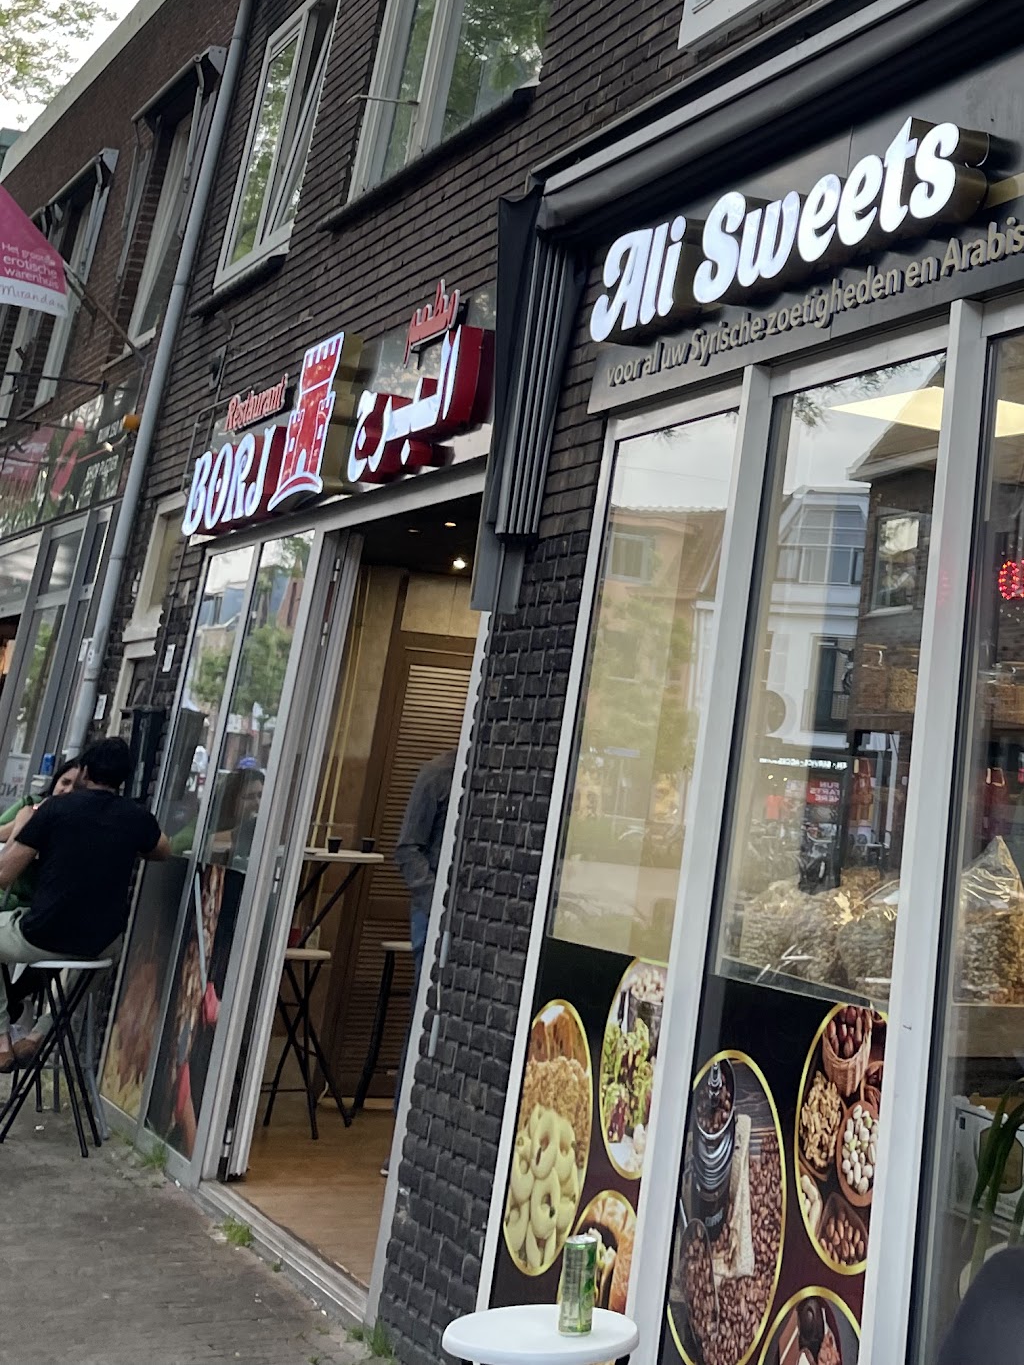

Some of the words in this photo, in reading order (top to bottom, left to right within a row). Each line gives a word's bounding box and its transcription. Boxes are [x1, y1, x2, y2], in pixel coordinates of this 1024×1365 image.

[590, 216, 686, 342] Ali
[692, 116, 961, 305] Sweets
[661, 342, 690, 370] uw
[690, 315, 764, 366] Syrische
[766, 265, 904, 335] zoetigheden
[904, 254, 939, 287] en
[224, 373, 288, 432] Restaurant
[182, 424, 276, 536] BORJ
